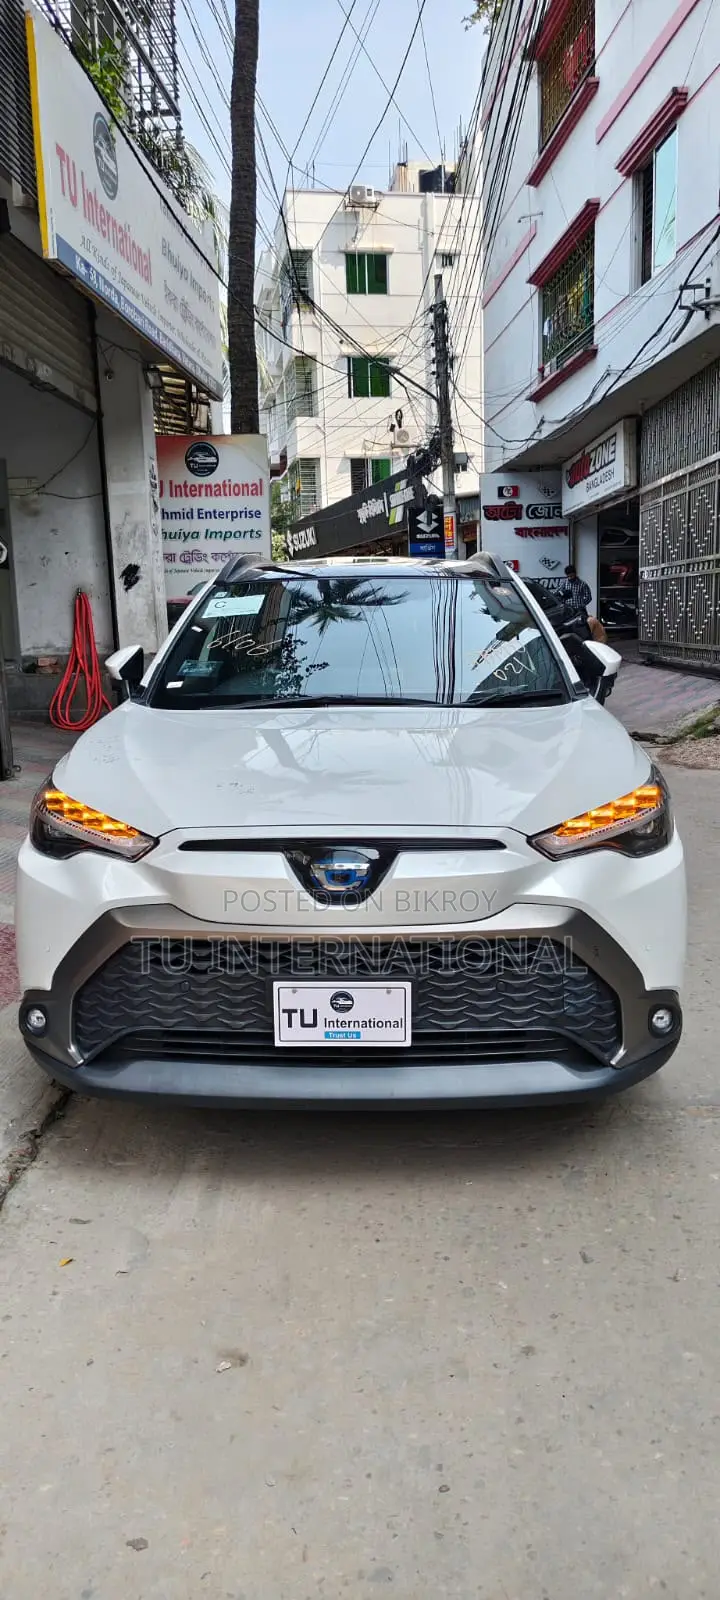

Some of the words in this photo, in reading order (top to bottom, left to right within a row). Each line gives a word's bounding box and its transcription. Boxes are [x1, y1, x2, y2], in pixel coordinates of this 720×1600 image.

[55, 142, 77, 209] TU
[81, 170, 152, 287] International
[170, 479, 263, 498] International
[586, 468, 615, 493] BANGLADESH
[161, 507, 194, 520] hmid
[197, 508, 262, 522] Enterprise
[484, 502, 522, 520] অটো
[161, 528, 200, 542] huiya
[204, 528, 262, 542] Imports
[293, 526, 317, 552] SUZUKI
[282, 1008, 318, 1028] TU
[324, 1017, 403, 1029] International
